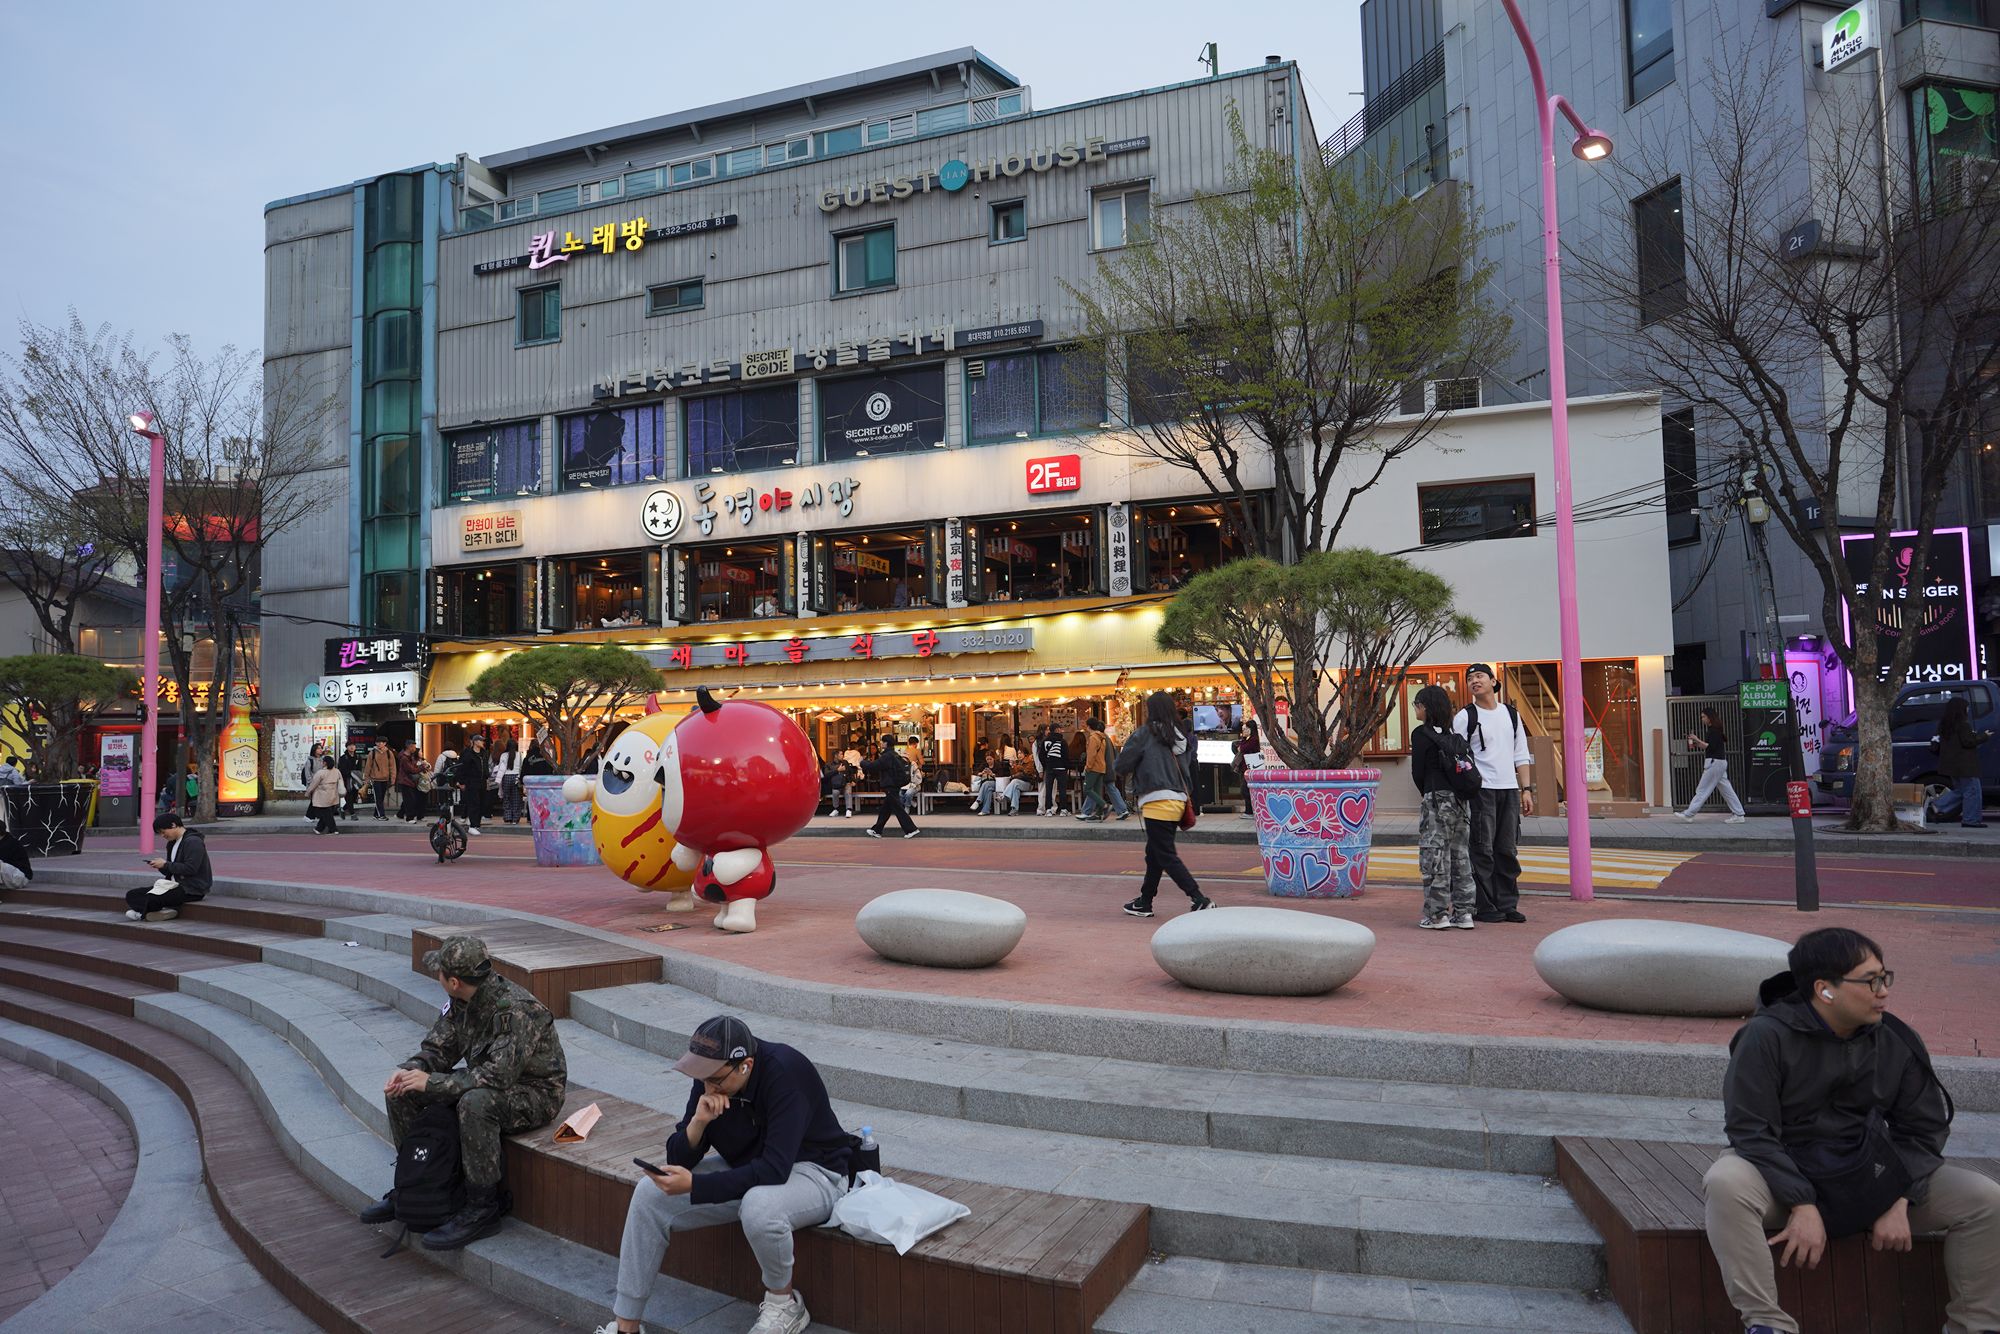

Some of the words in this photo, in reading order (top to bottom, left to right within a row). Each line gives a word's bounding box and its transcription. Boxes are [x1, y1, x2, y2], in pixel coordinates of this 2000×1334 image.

[1831, 36, 1862, 57] MUSIC
[1831, 42, 1863, 65] PLANT
[819, 168, 936, 212] GUEST
[940, 169, 967, 182] LIAN
[973, 135, 1107, 183] HOUSE
[715, 218, 727, 226] B1
[1790, 235, 1804, 250] 2F
[967, 330, 992, 342] 홍대직영점
[993, 325, 1031, 338] 010.2185.6561
[805, 324, 955, 371] 방탈출카페
[746, 350, 788, 364] SECRET
[746, 360, 788, 377] CODE
[600, 357, 731, 398] 시크릿코드
[845, 426, 882, 439] SECRET
[883, 422, 913, 434] CODE
[854, 432, 904, 443] www.s-code.co.kr
[1030, 462, 1060, 490] 2F
[1056, 476, 1077, 488] 홍대점
[692, 477, 861, 536] 동경야시장
[1806, 506, 1821, 520] 1F
[466, 517, 494, 532] 만원이
[496, 515, 516, 529] 넘는
[464, 532, 492, 546] 안주가
[494, 529, 518, 544] 없다!
[1113, 530, 1126, 573] 小料理
[950, 526, 963, 603] 東京夜市場
[1898, 585, 1959, 599] SGER
[961, 632, 1025, 648] 332-0120
[338, 639, 402, 668] 퀸노래방
[670, 629, 941, 670] 새마을식당
[344, 679, 408, 702] 동경시장
[1742, 684, 1777, 692] K-POP
[1742, 692, 1777, 700] ALBUM
[1752, 699, 1787, 707] MERCH
[1803, 738, 1822, 754] 맥주
[235, 769, 254, 778] Kelly
